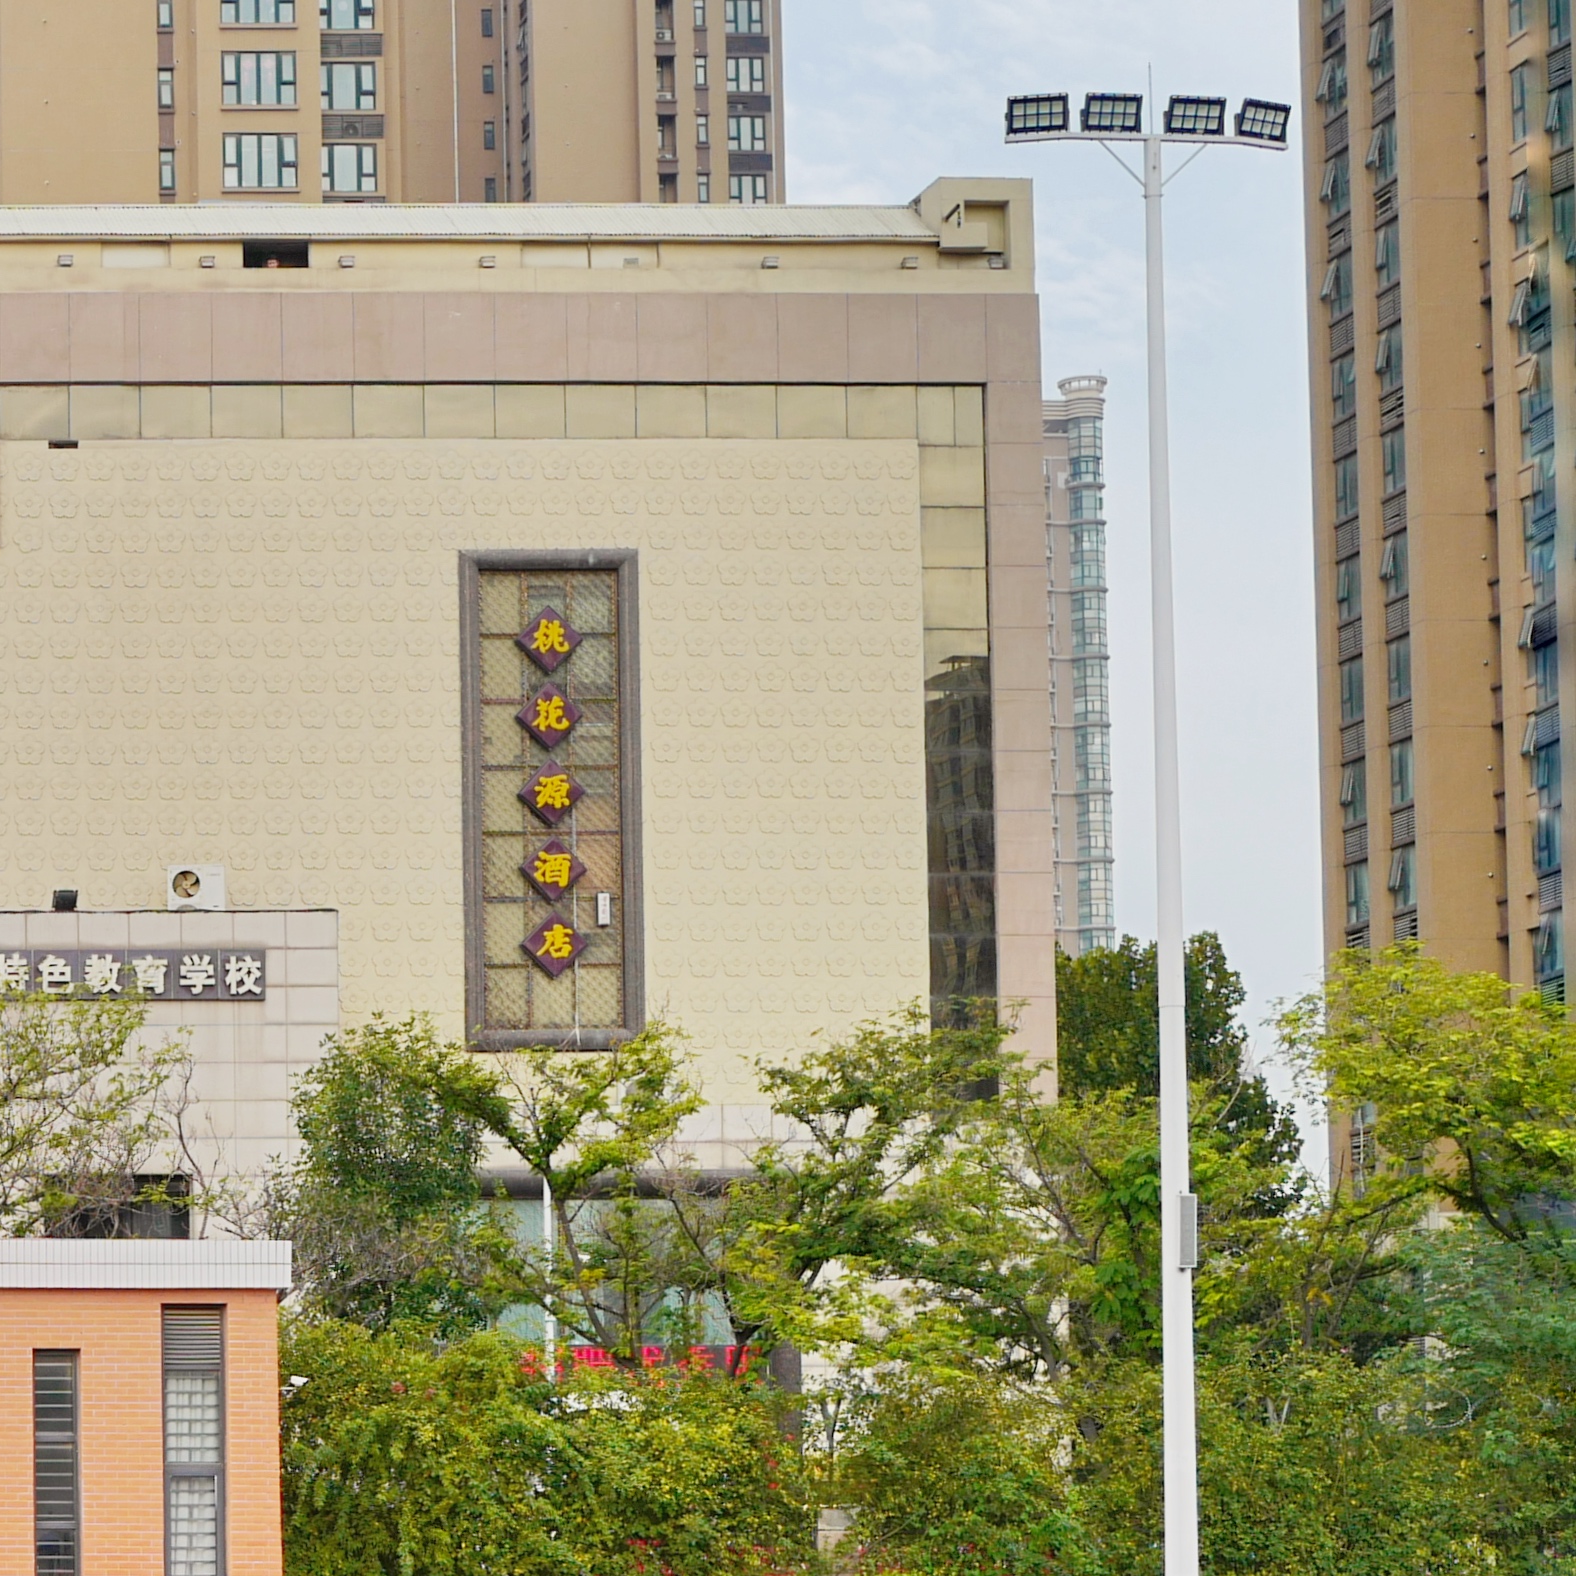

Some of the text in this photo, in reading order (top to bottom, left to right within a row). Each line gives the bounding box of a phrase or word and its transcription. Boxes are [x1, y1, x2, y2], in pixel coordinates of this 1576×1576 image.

[530, 618, 574, 960] 桃花源酒店
